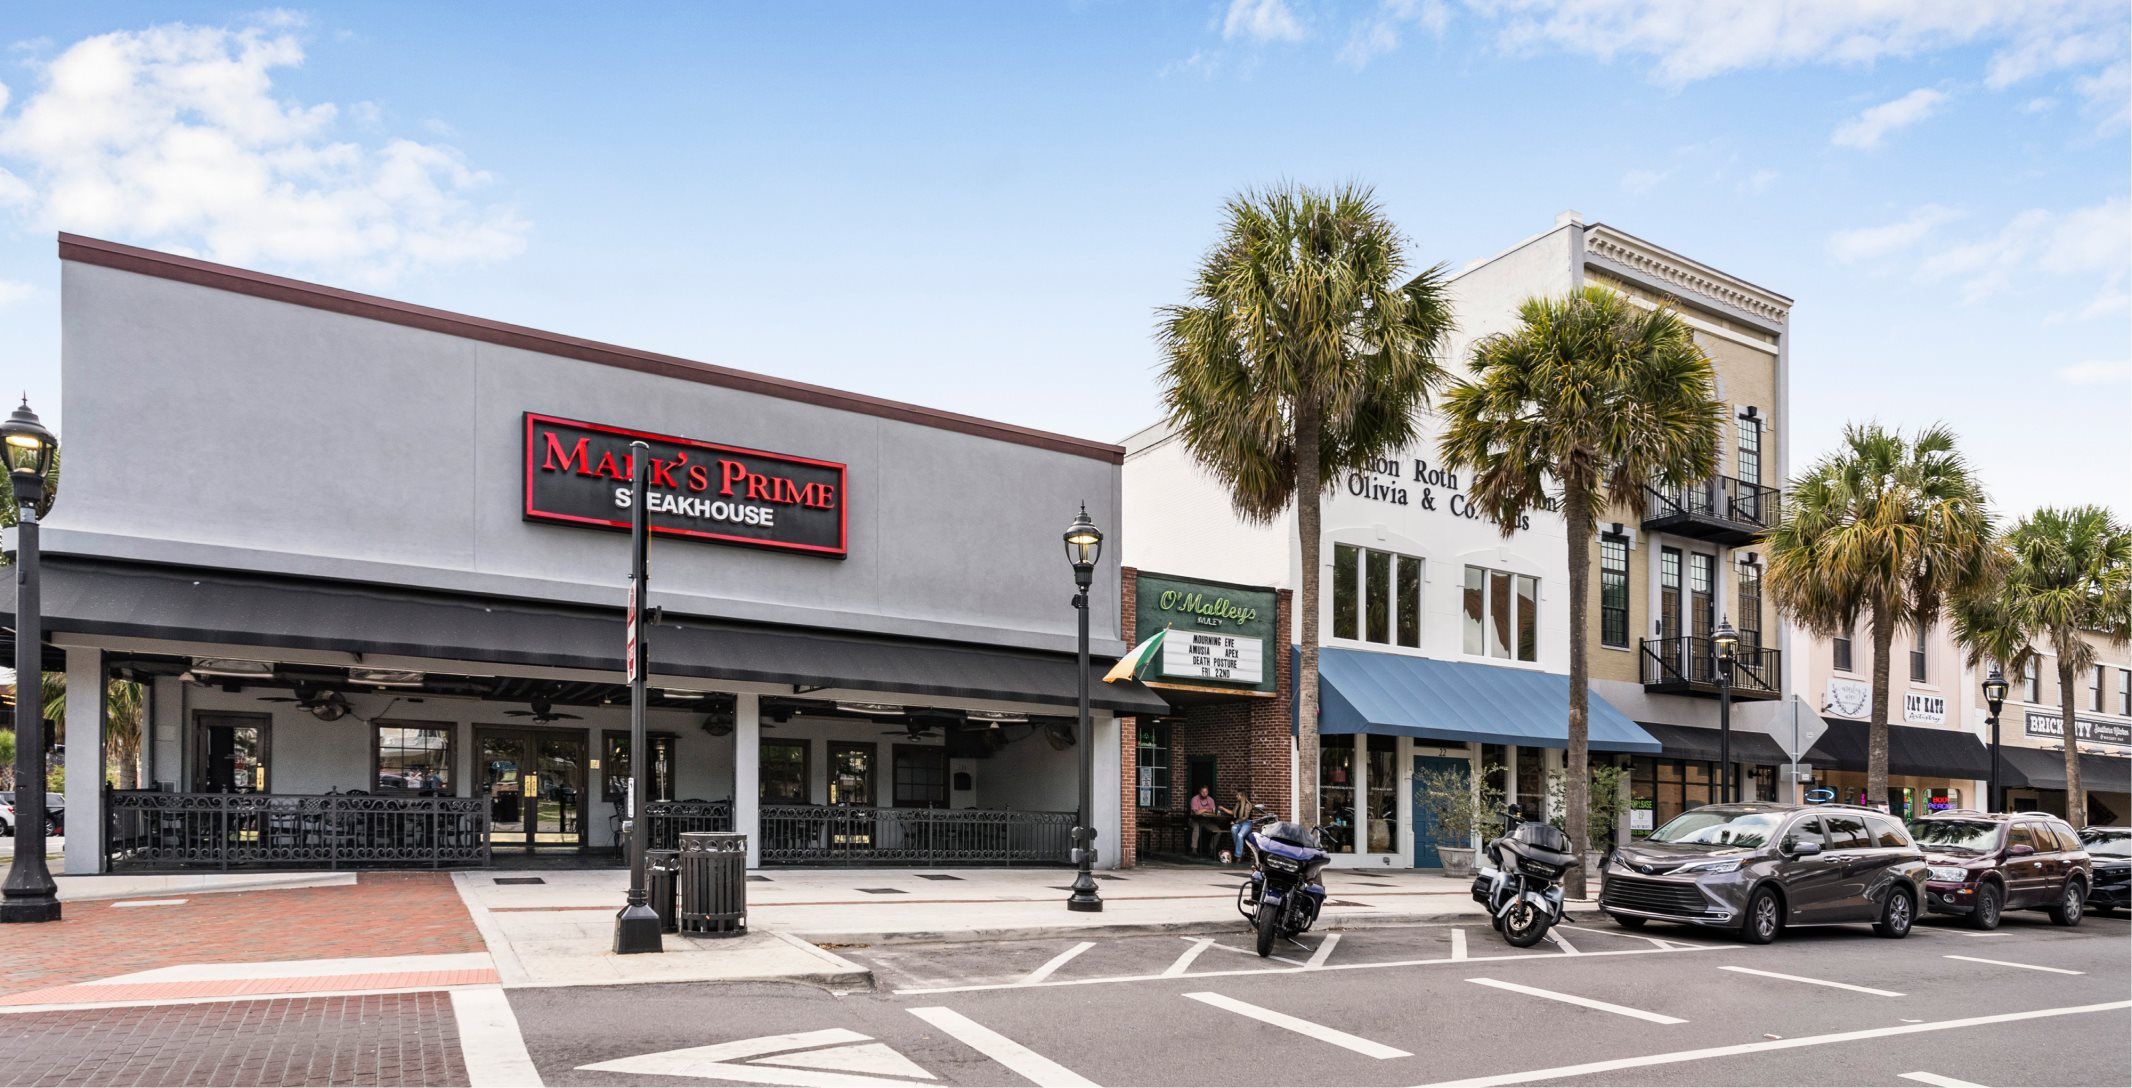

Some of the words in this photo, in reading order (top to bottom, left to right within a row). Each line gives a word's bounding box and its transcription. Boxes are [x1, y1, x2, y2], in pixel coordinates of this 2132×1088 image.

[719, 459, 836, 511] PRIME
[1413, 459, 1458, 490] Roth
[615, 488, 774, 527] SEAKHOUSE
[1348, 473, 1408, 505] Olivia
[1421, 487, 1436, 511] &
[1450, 494, 1479, 520] Co.
[1160, 590, 1256, 625] O'Malleys
[1189, 645, 1210, 656] AMUSIA
[1225, 649, 1238, 659] APEX
[1193, 635, 1221, 646] MOURNING
[1225, 638, 1234, 648] EVE
[1193, 656, 1210, 666] DEATH
[1214, 658, 1237, 669] POSTURE
[1202, 667, 1210, 678] FRI
[1215, 668, 1230, 679] 22ND
[2030, 715, 2064, 735] BRICK
[2074, 721, 2092, 737] ITY
